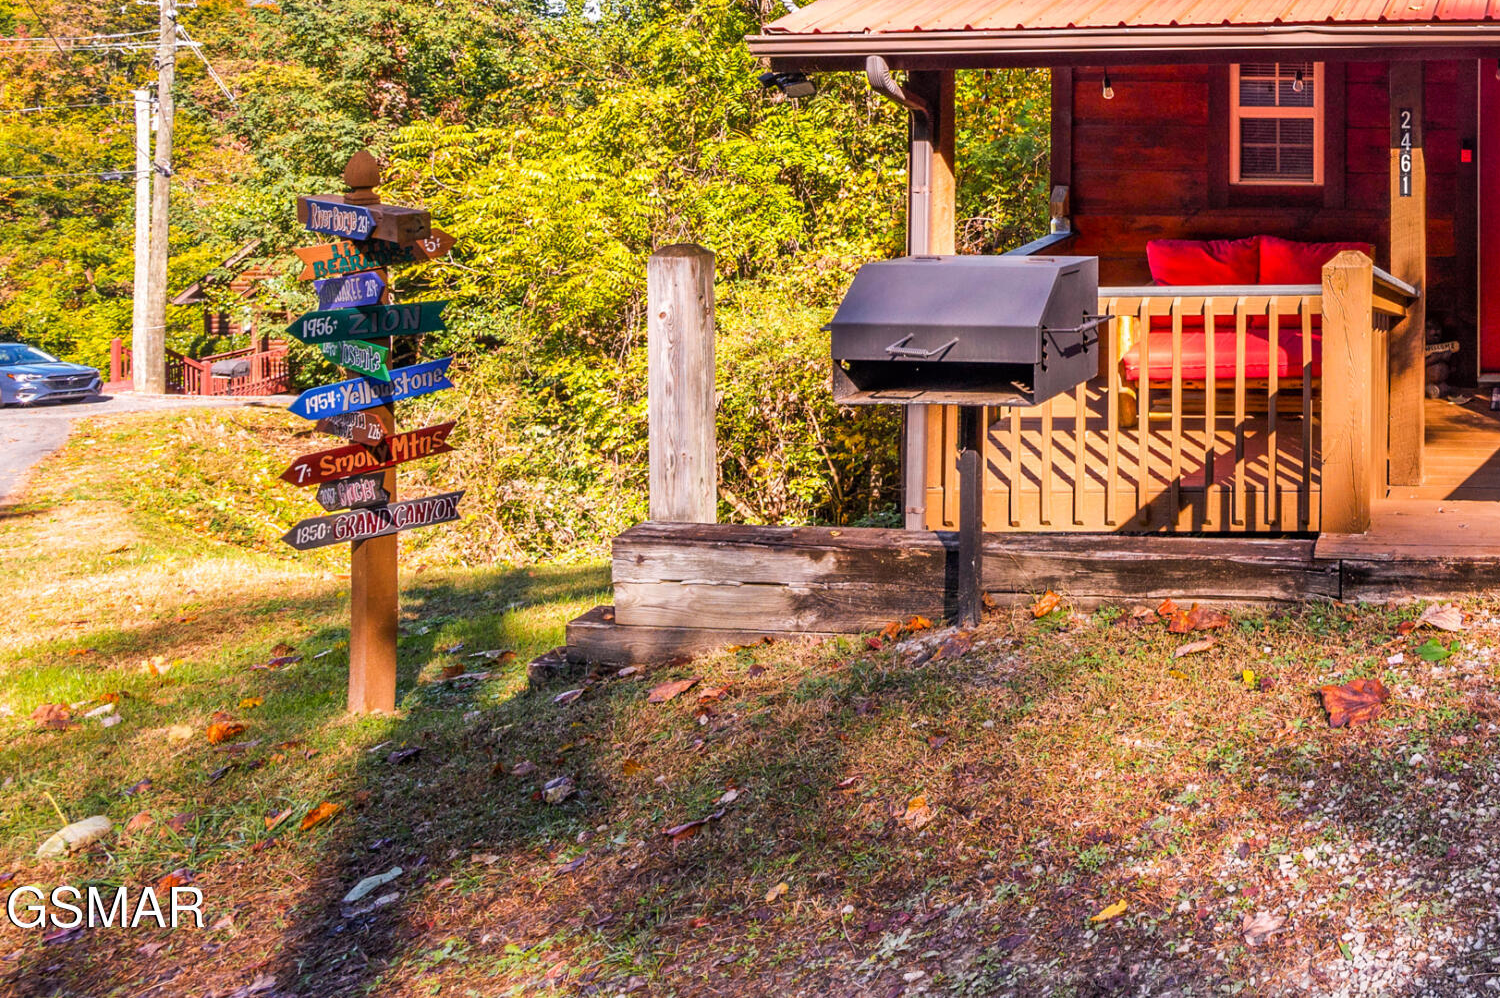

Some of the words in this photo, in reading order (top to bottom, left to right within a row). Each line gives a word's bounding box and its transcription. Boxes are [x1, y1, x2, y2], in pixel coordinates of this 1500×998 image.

[1401, 110, 1411, 194] 2461
[311, 203, 332, 229] River
[349, 305, 421, 335] ZION
[338, 341, 381, 372] Yosemite
[339, 368, 443, 411] Yellowstone
[391, 430, 445, 462] Mtns
[337, 478, 376, 507] Glacier
[333, 507, 393, 541] GRAND
[393, 495, 459, 529] CANYON
